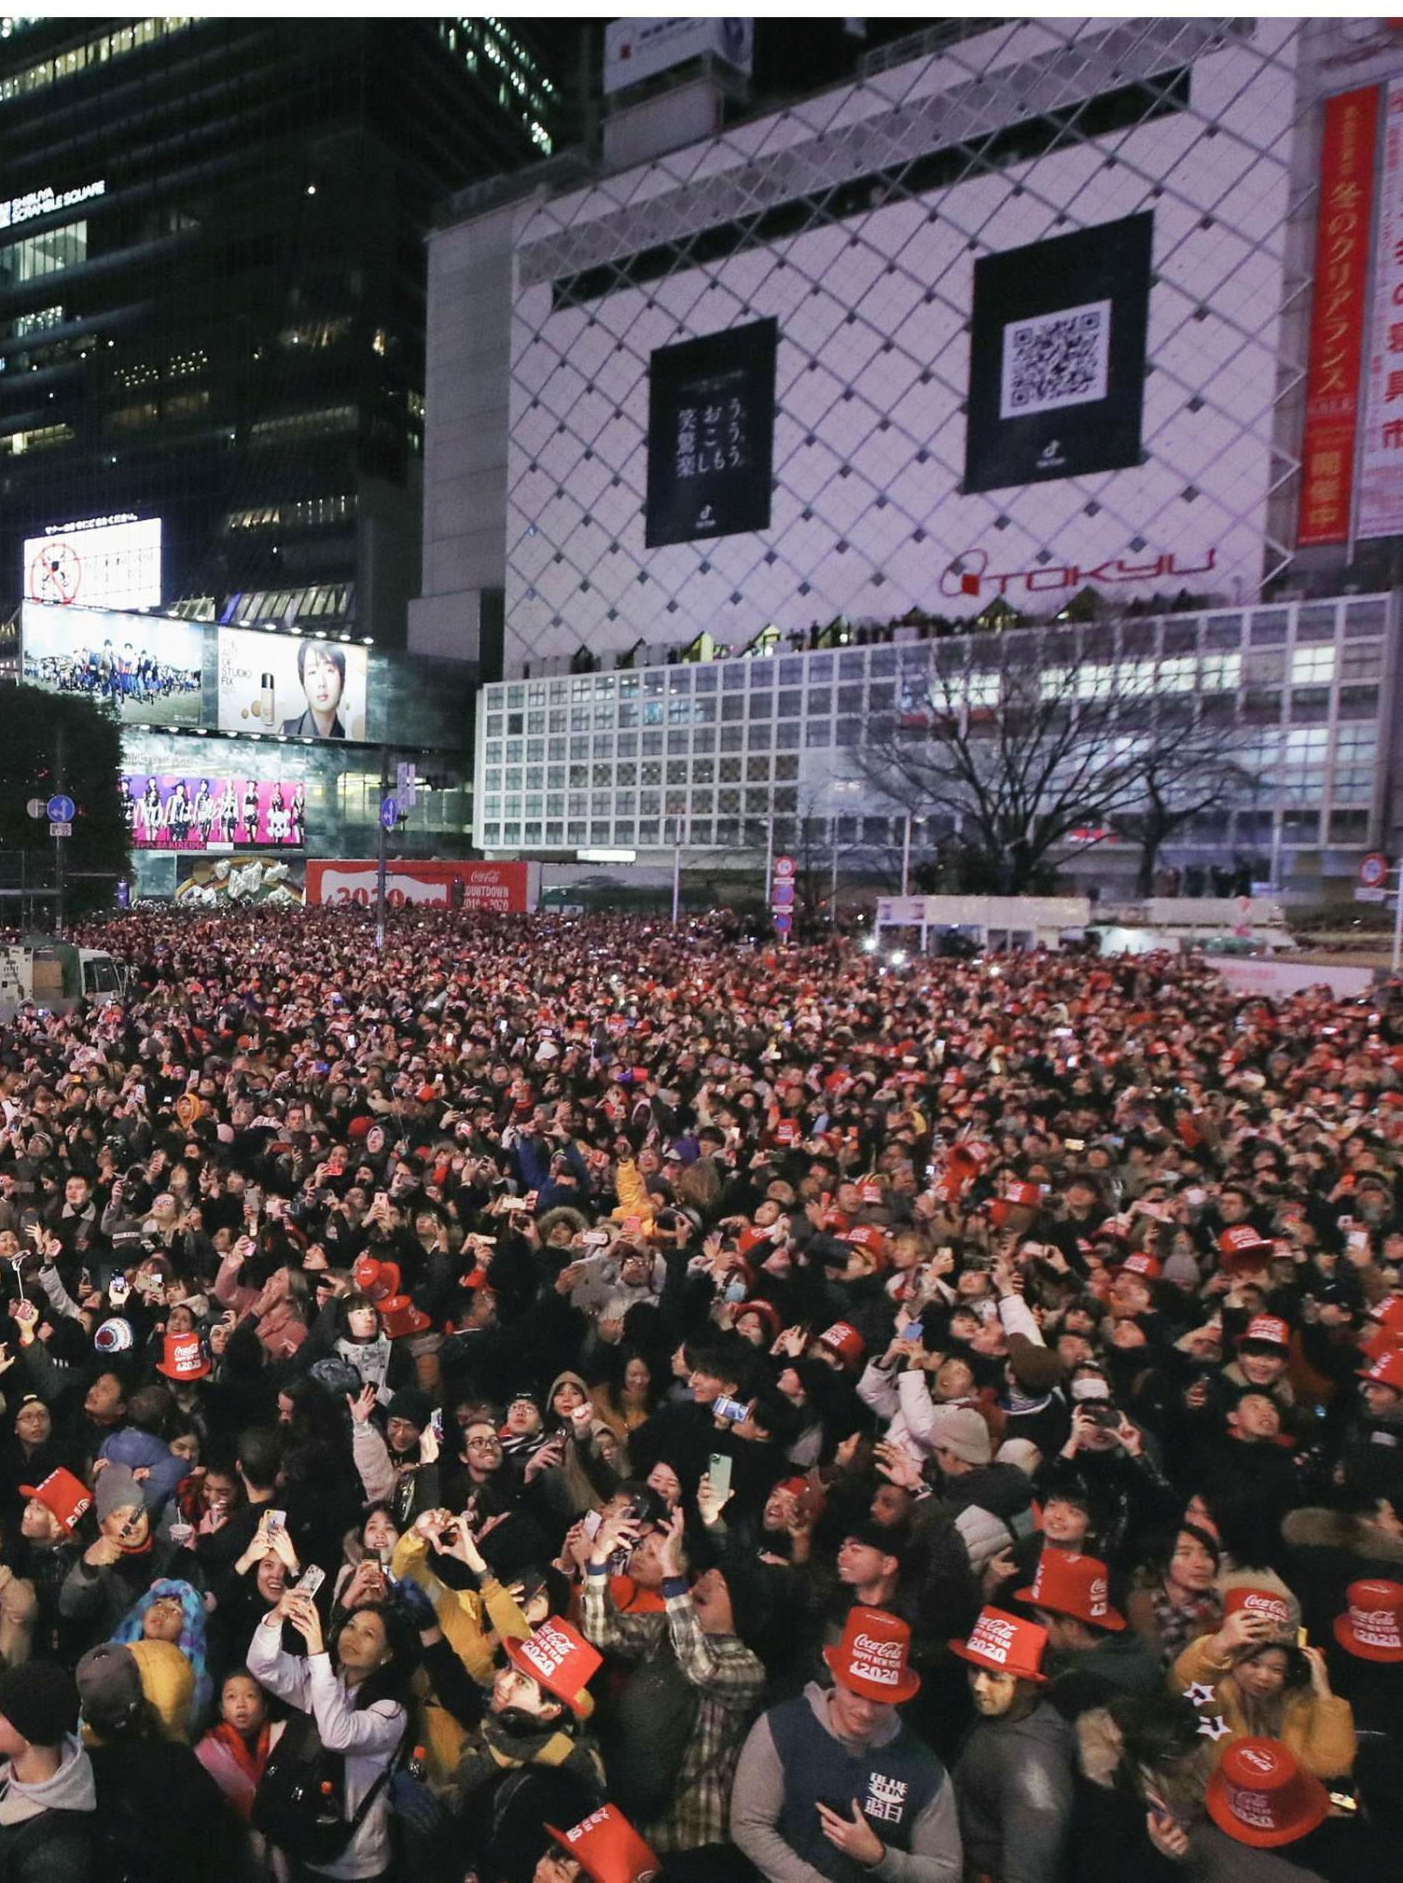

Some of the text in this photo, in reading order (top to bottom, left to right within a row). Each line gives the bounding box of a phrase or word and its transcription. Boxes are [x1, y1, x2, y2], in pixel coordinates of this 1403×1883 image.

[64, 179, 105, 206] SQUARE
[1317, 181, 1362, 396] 冬のクリアランス
[981, 547, 1217, 594] TOKYU
[221, 668, 252, 678] STUDIO
[221, 677, 234, 685] FIX
[853, 1633, 903, 1659] Coca-Cola
[858, 1663, 899, 1683] 2020
